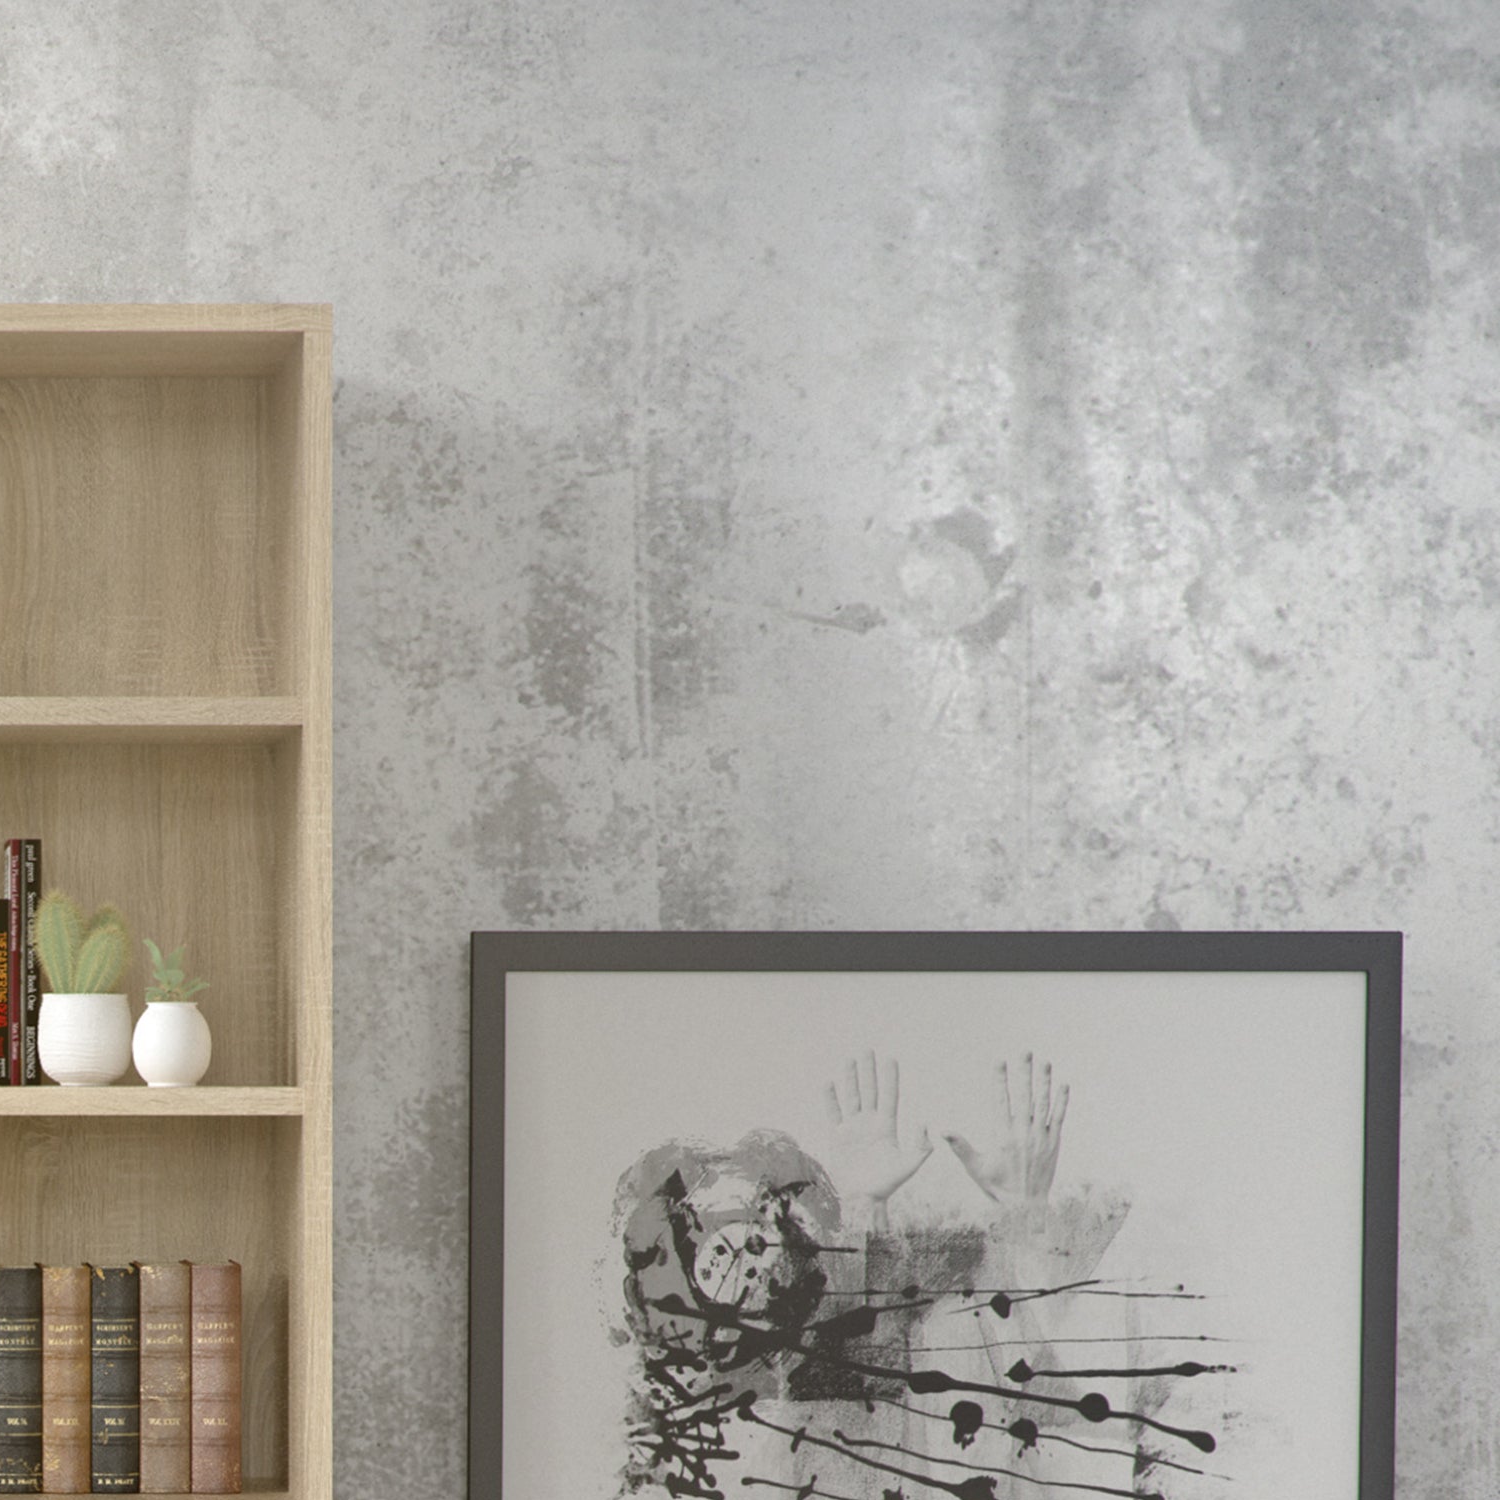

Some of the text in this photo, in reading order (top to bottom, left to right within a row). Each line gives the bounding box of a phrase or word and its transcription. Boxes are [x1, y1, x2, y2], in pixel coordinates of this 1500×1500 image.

[25, 844, 36, 883] paul green
[27, 891, 36, 918] Second
[27, 947, 36, 969] Series
[27, 975, 36, 994] Book
[27, 995, 36, 1011] One
[26, 1026, 36, 1079] BEGINNINGS
